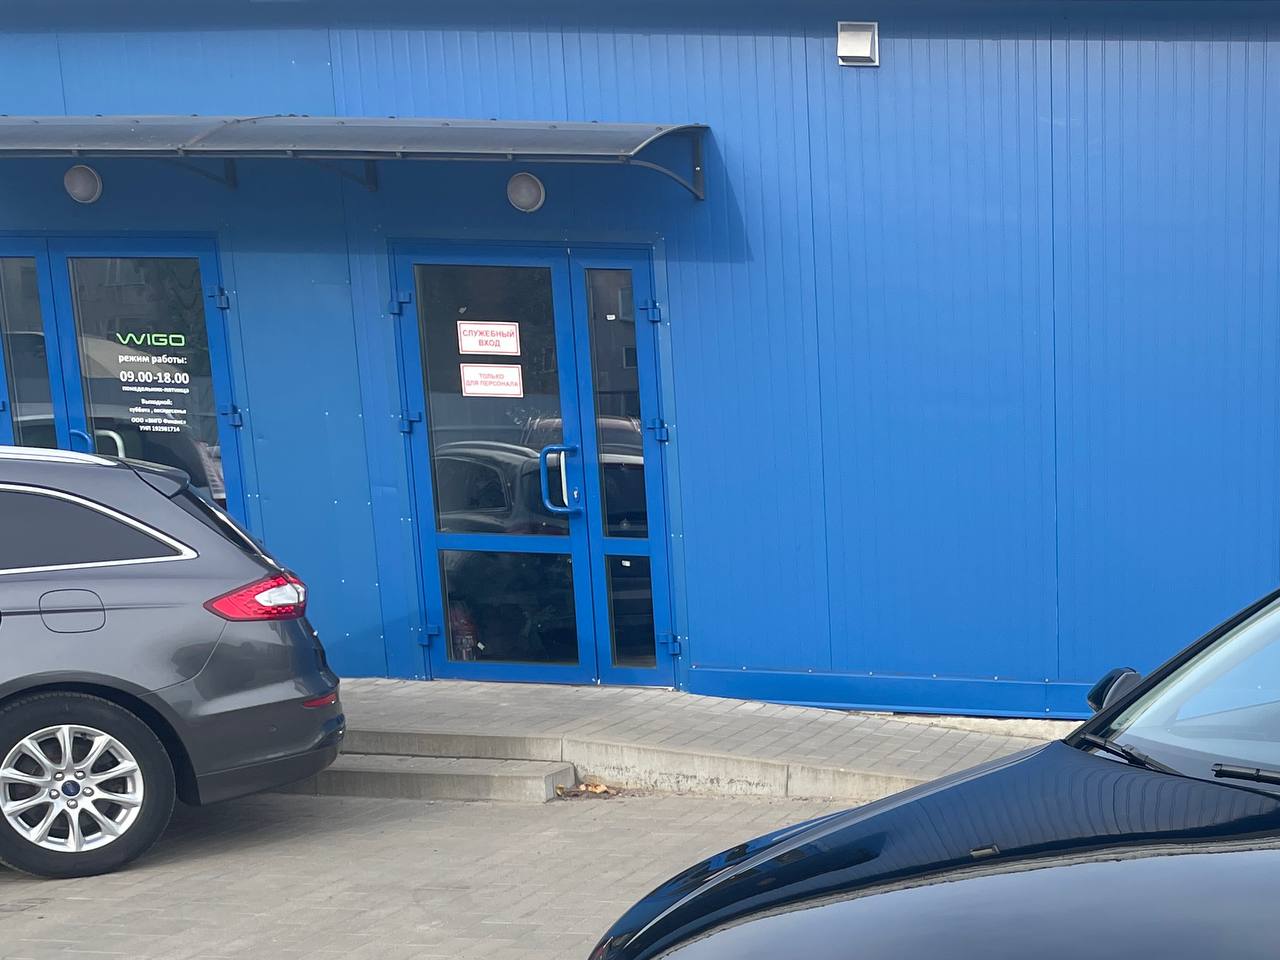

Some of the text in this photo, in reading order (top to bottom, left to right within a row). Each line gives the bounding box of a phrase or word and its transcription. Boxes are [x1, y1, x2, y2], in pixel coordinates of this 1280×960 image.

[462, 329, 515, 338] СЛУЖЕБНЫЙ
[116, 332, 185, 346] WIGO
[478, 339, 501, 347] ВХОД
[118, 354, 188, 365] режим работы:
[119, 370, 190, 385] 09.00-18.00
[465, 379, 519, 388] ДЛЯ ПЕРСОНАЛА
